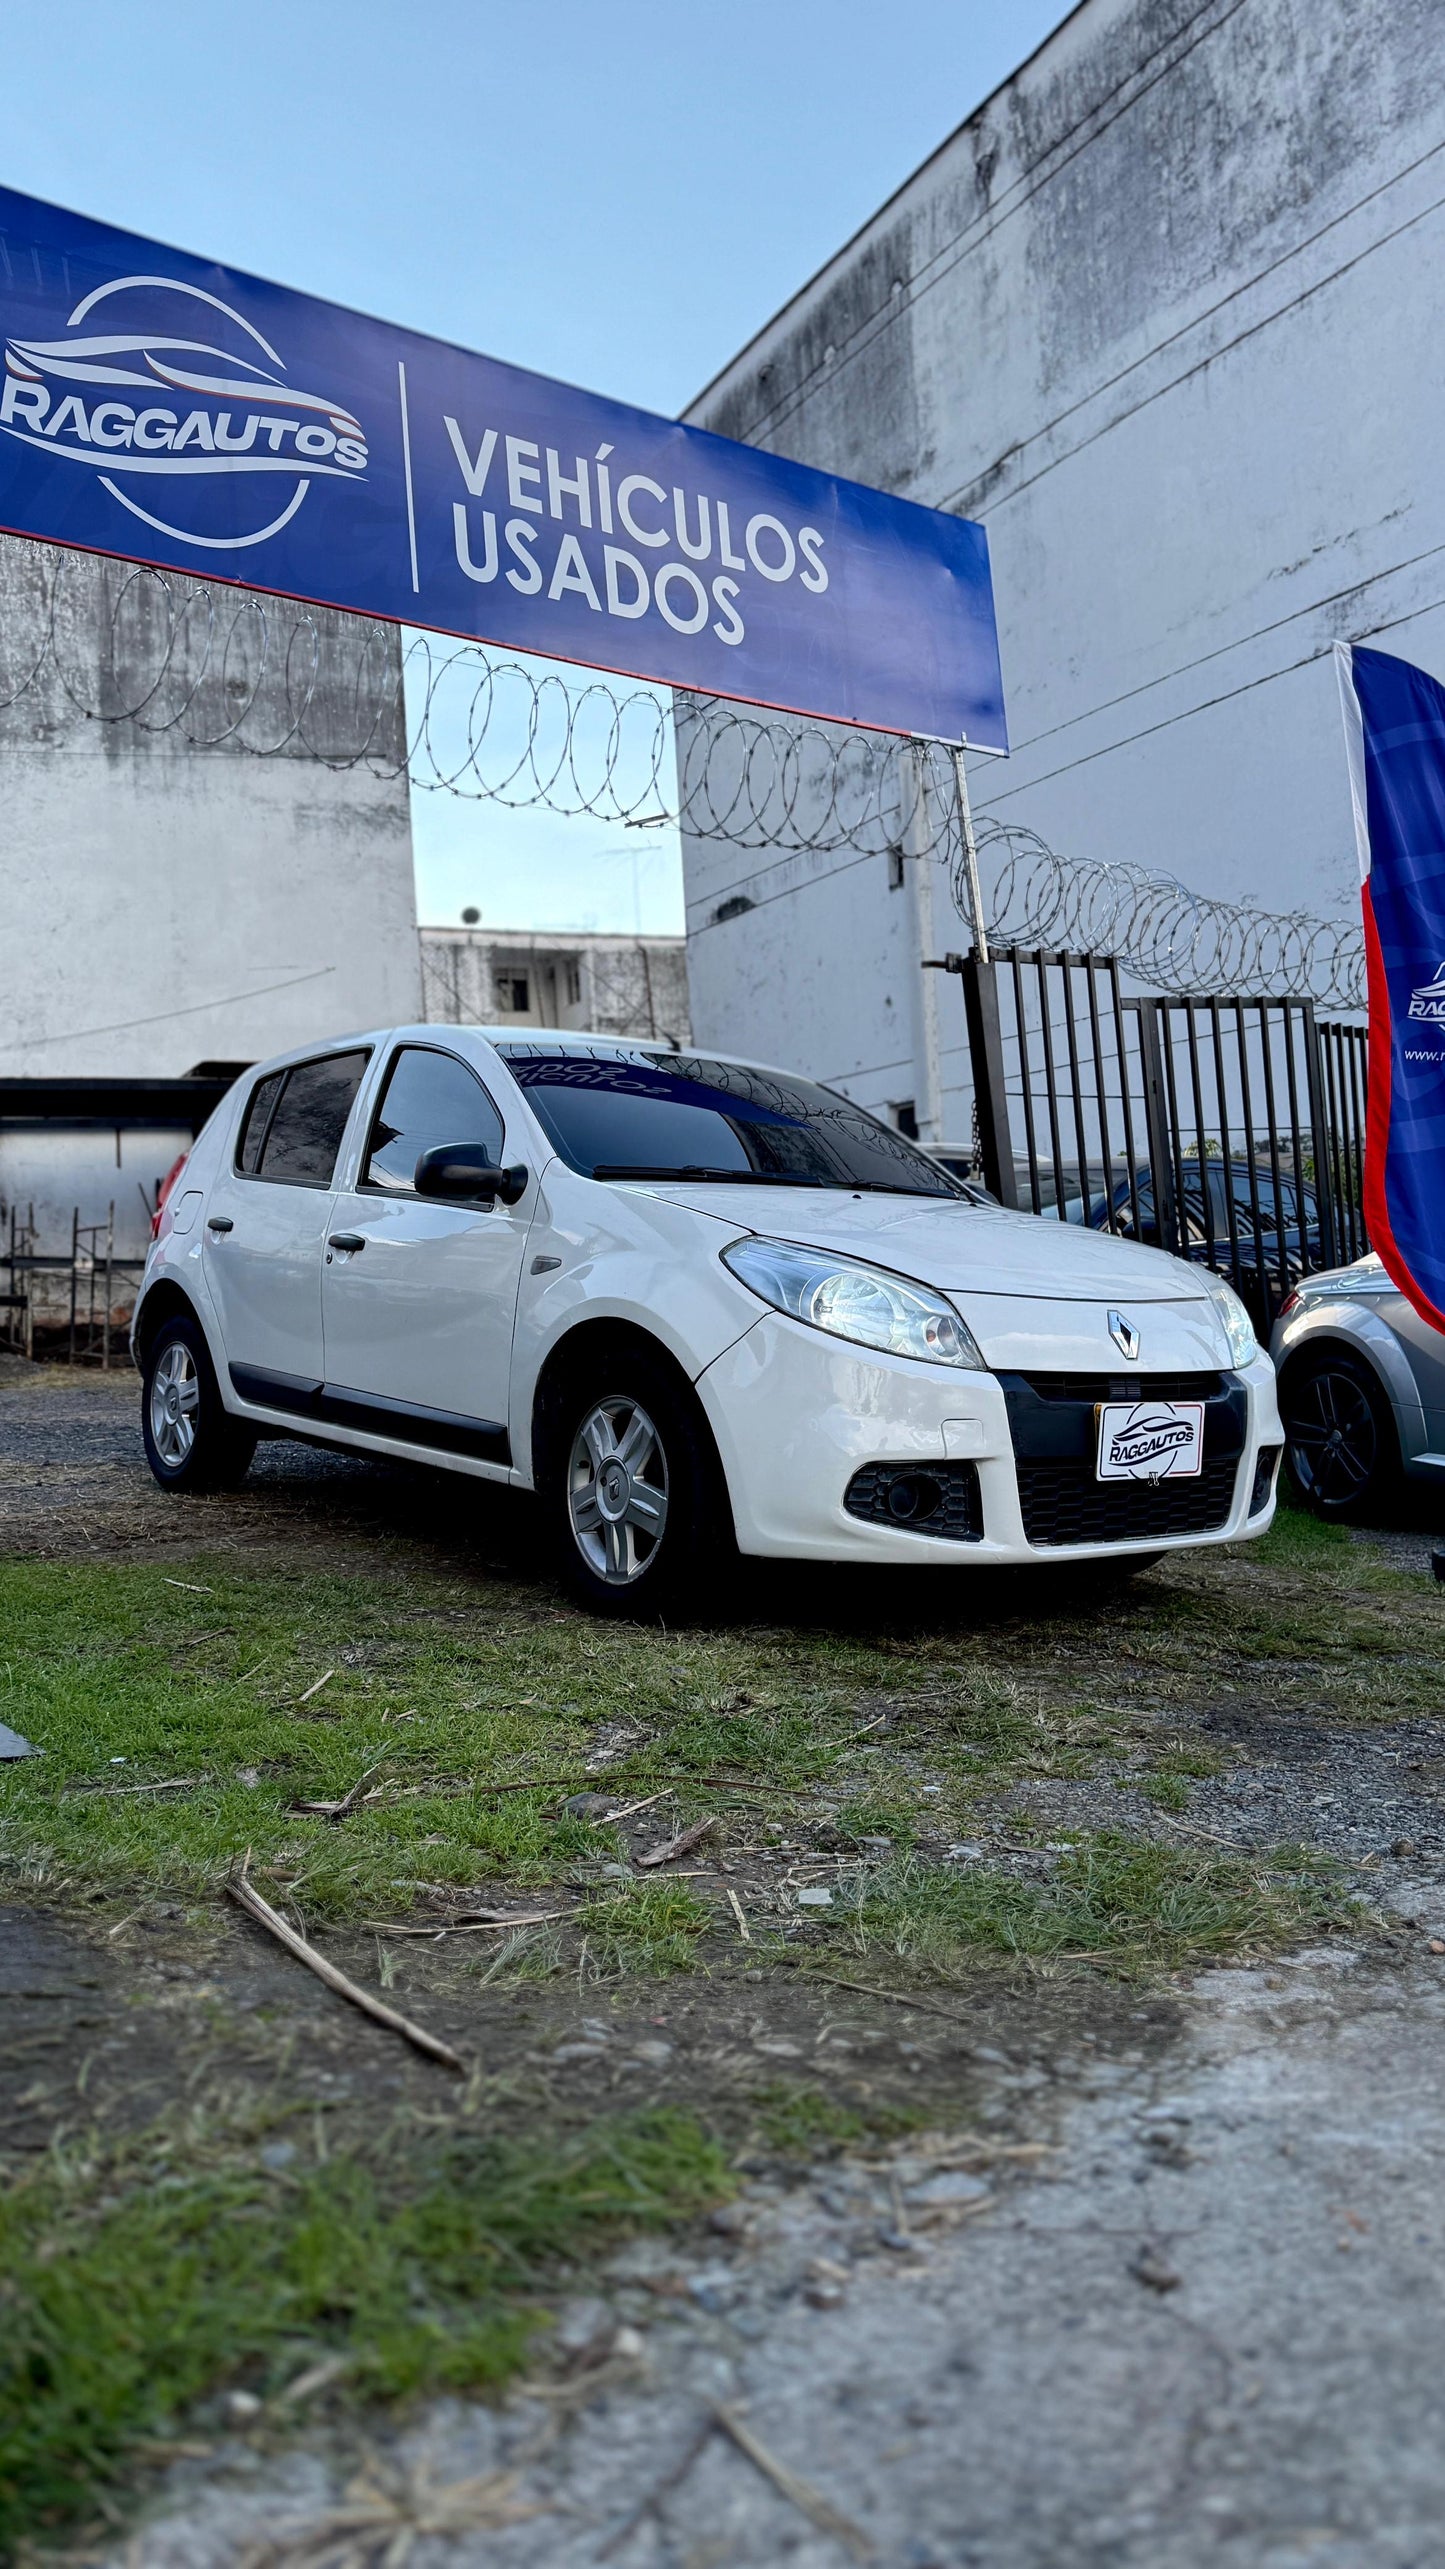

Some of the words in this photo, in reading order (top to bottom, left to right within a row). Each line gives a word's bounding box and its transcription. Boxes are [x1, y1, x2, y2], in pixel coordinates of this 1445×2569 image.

[0, 374, 369, 470] RAGGAUTOS
[443, 415, 830, 593] VEHÍCULOS
[453, 502, 745, 646] USADOS
[1109, 1430, 1194, 1462] RAGGAUTOS
